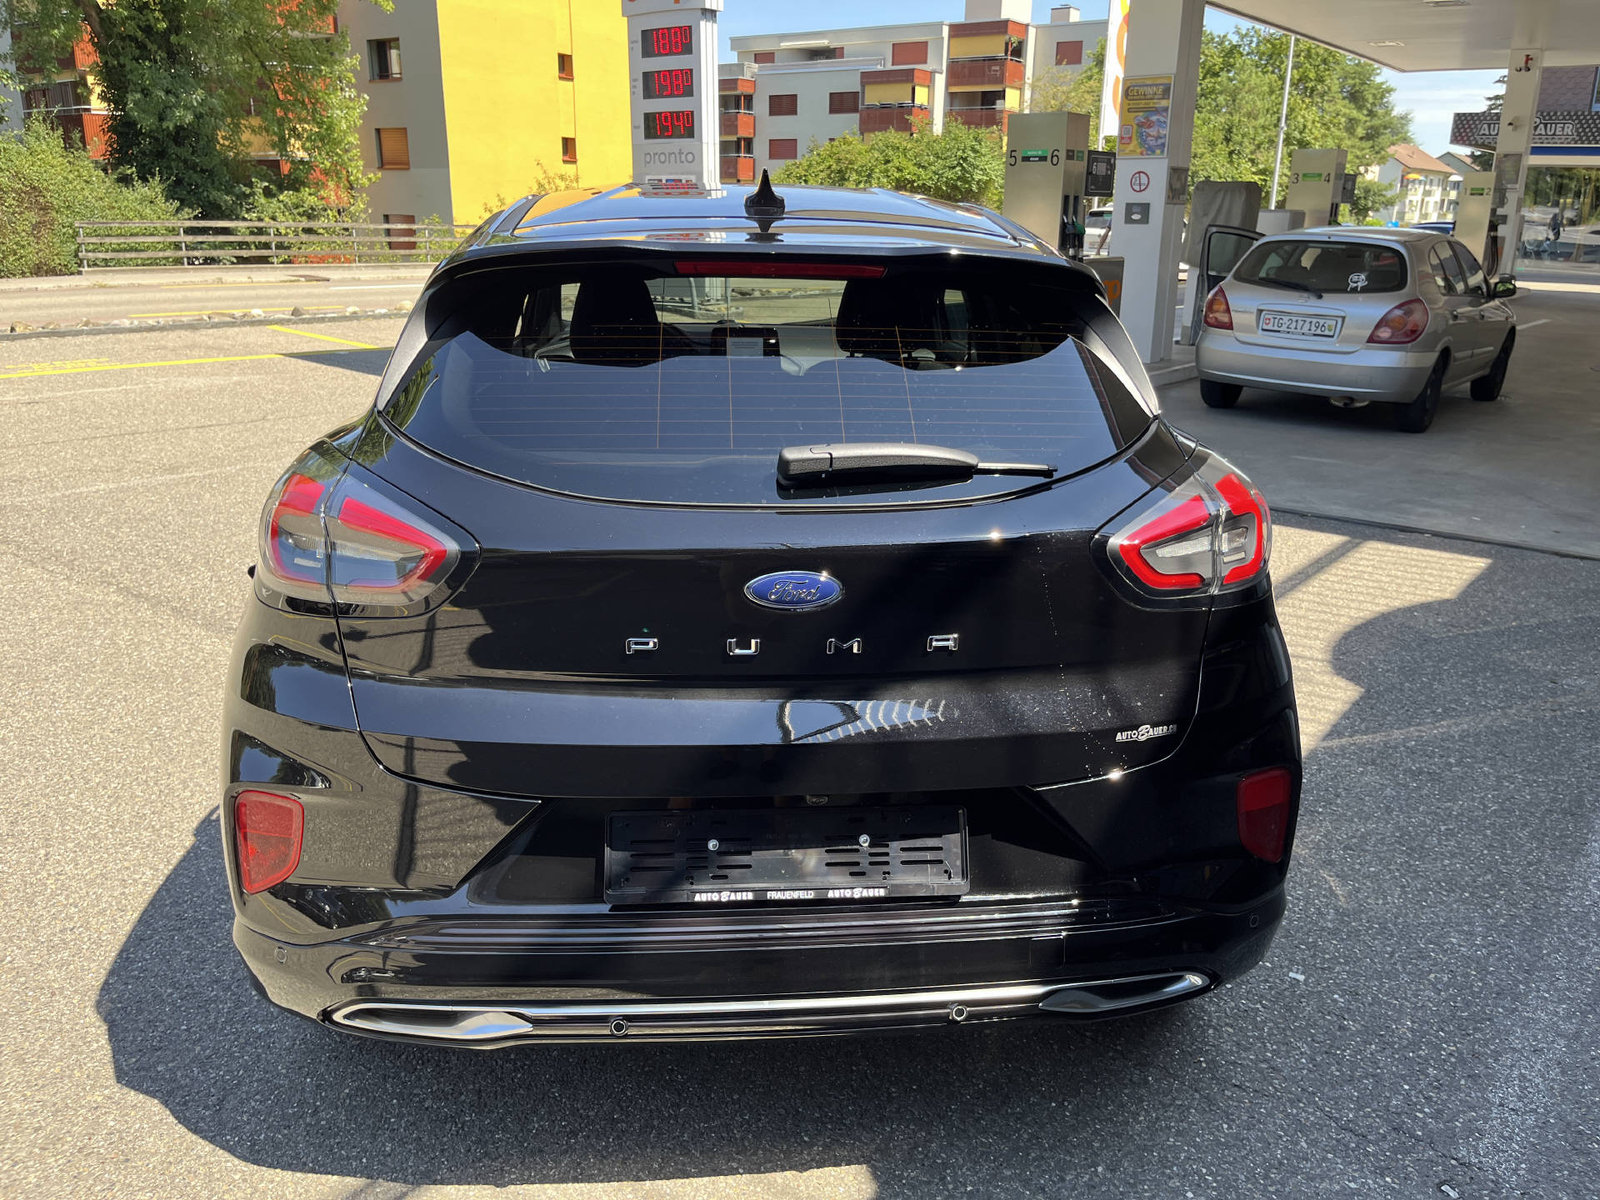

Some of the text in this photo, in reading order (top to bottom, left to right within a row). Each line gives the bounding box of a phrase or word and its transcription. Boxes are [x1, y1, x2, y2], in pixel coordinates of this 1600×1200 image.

[644, 148, 695, 166] pronto
[1009, 149, 1017, 166] 5
[1050, 149, 1060, 166] 6
[1292, 172, 1331, 184] 3 4
[768, 579, 821, 601] Ford
[625, 633, 959, 655] PUMA
[766, 891, 814, 899] FRAUENFELD
